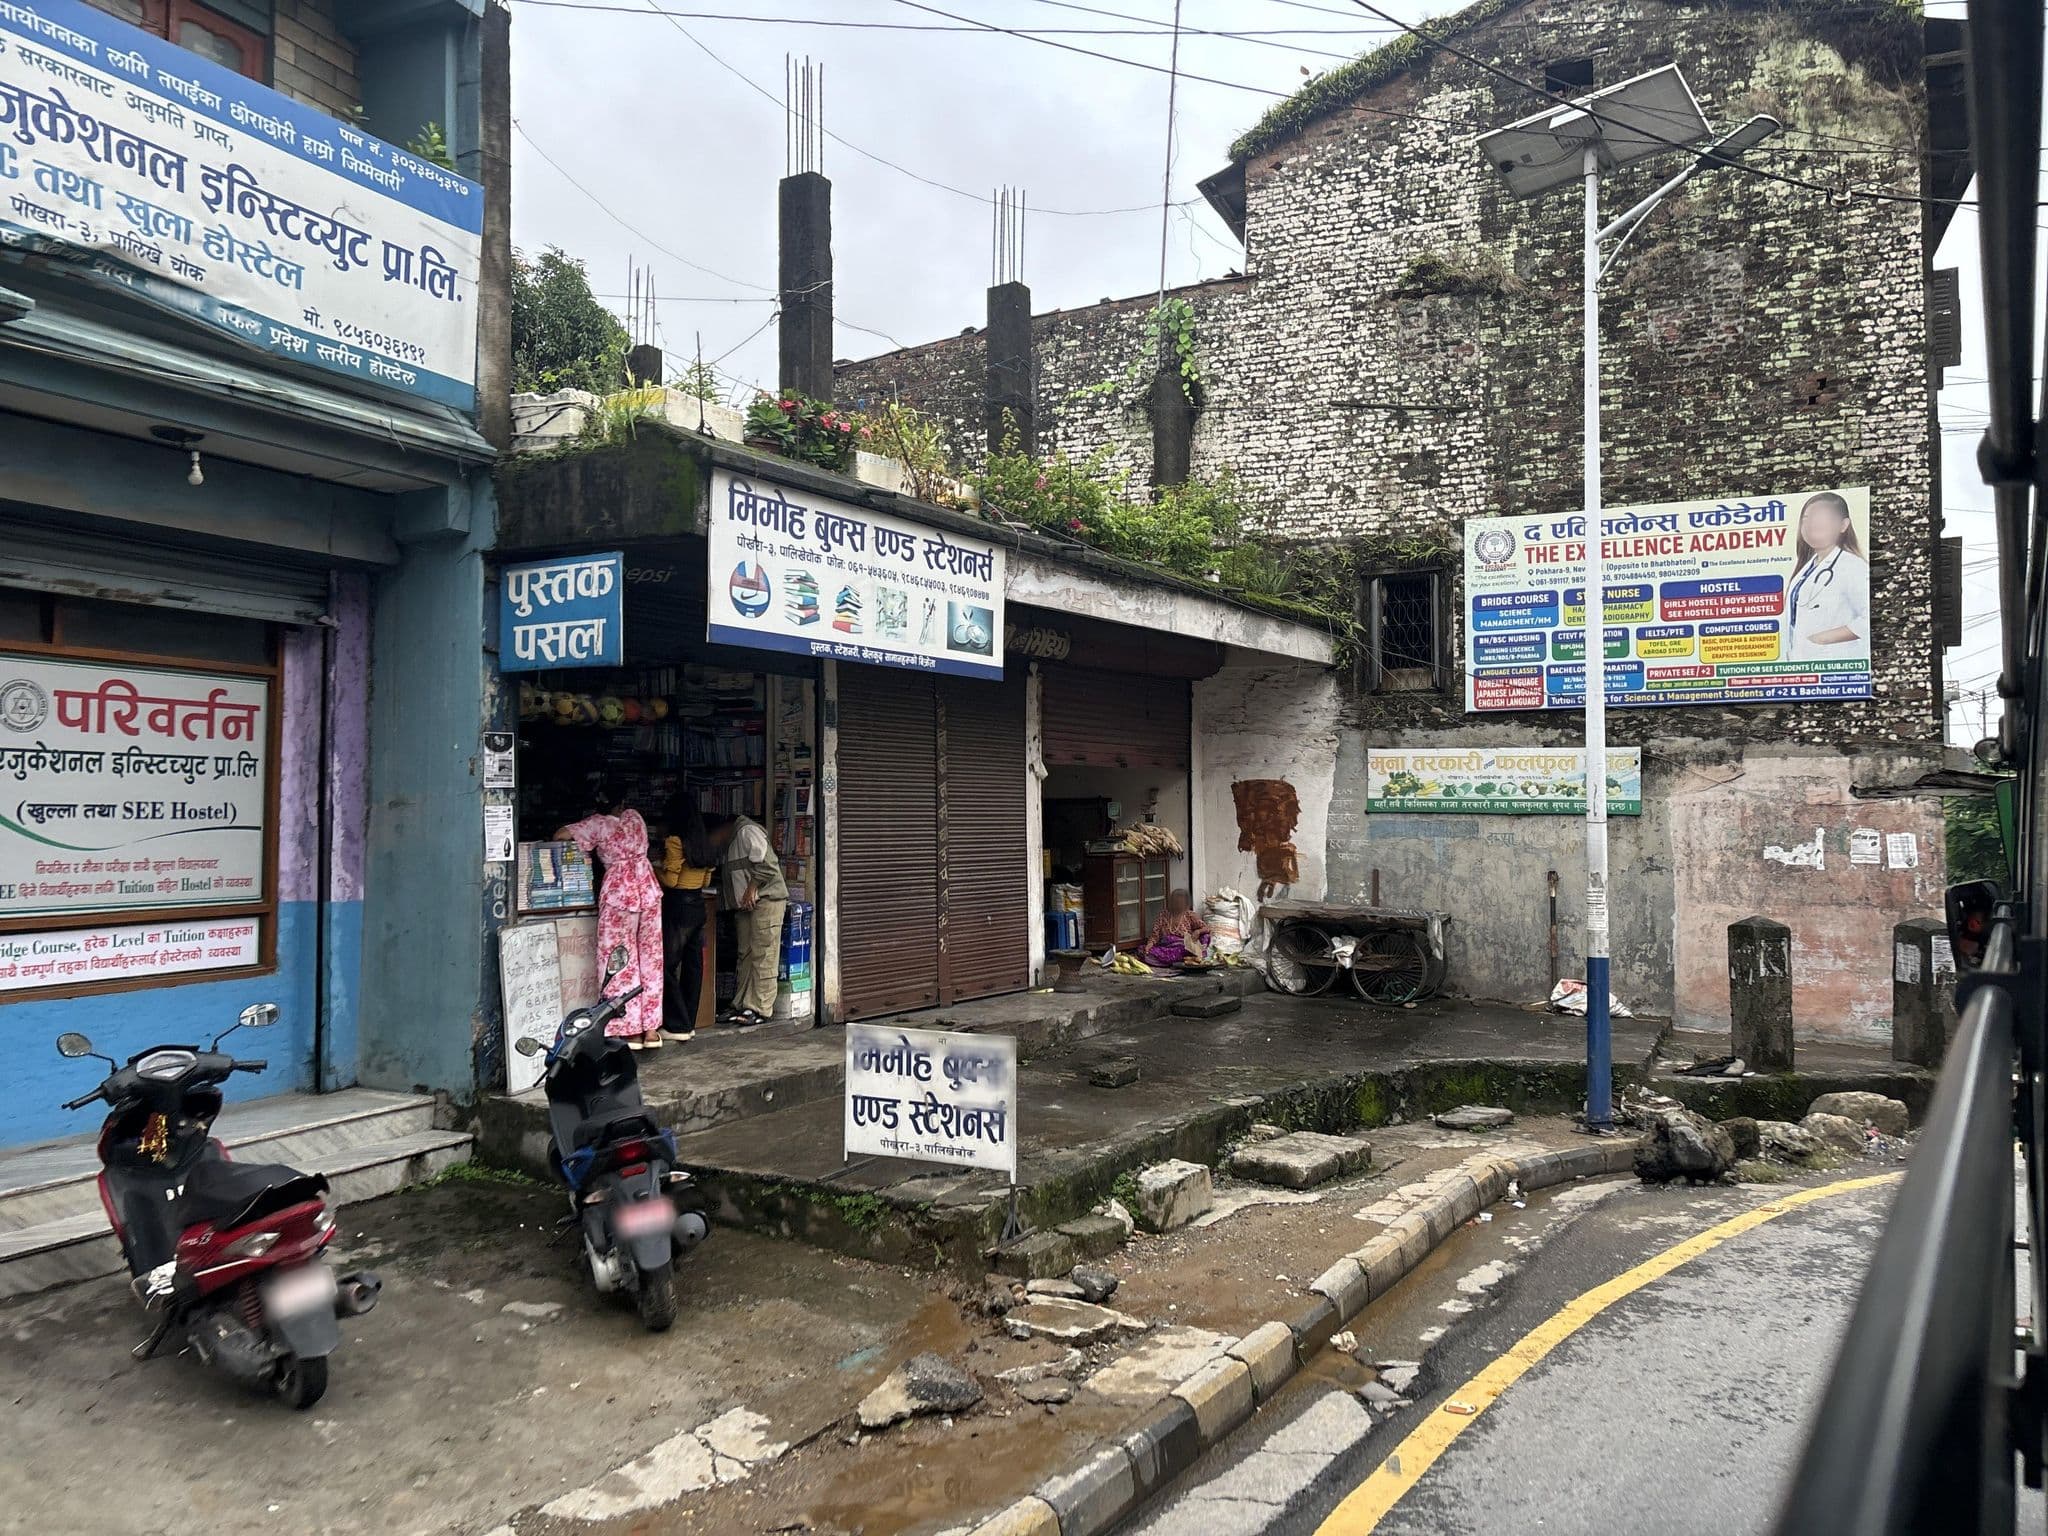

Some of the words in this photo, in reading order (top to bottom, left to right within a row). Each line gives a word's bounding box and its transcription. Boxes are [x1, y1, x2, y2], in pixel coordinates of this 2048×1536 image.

[106, 47, 149, 79] लागि
[302, 133, 335, 163] हाम्रो
[124, 91, 184, 130] अनुमति
[33, 159, 103, 211] तथा
[115, 190, 193, 245] खुला
[203, 223, 305, 291] होस्टेल
[170, 254, 206, 282] चोक
[270, 327, 310, 354] प्रदेश
[316, 342, 363, 369] स्तरीय
[368, 356, 417, 386] होस्टेल
[1524, 524, 1543, 541] द
[1688, 500, 1787, 527] एकेडेमी
[728, 478, 807, 540] मिमोह
[815, 510, 867, 553] बुक्स
[874, 526, 917, 562] एण्ड
[923, 533, 994, 582] स्टेशनर्स
[1525, 545, 1559, 564] THE
[1566, 536, 1684, 562] EXELLENCE
[1690, 528, 1787, 552] ACADEMY
[506, 559, 617, 617] पुस्तक
[1607, 588, 1640, 598] NURSE
[1700, 582, 1741, 593] HOSTEL
[1481, 597, 1513, 607] BRIDGE
[1514, 593, 1550, 605] COURSE
[1688, 599, 1719, 607] HOSTEL
[1725, 597, 1744, 605] BOYS
[1745, 595, 1779, 603] HOSTEL
[1603, 612, 1650, 621] ADIOGRAPHY
[1684, 609, 1715, 617] HOSTEL
[1720, 607, 1743, 615] OPEN
[1744, 605, 1776, 613] HOSTEL
[1645, 628, 1685, 637] IELTS/PTE
[1705, 625, 1744, 634] COMPUTER
[1745, 623, 1773, 631] COURSE
[1508, 633, 1540, 642] NURSING
[1479, 668, 1510, 676] LANGUAGE
[1511, 666, 1538, 675] CLASSES
[1650, 669, 1681, 677] PRIVATE
[1719, 666, 1746, 674] TUITION
[1761, 665, 1774, 673] SEE
[1774, 664, 1810, 672] STUDENTS
[1827, 661, 1866, 670] SUBJECTS)
[1478, 679, 1505, 688] KOREAN
[1506, 677, 1538, 687] LANGUAGE
[1477, 689, 1507, 698] JAPANESE
[1624, 694, 1658, 702] Science
[1667, 690, 1722, 702] Management
[1724, 688, 1764, 698] Students
[1765, 688, 1775, 696] of
[1777, 688, 1789, 696] +2
[1799, 686, 1840, 695] Bachelor
[1842, 685, 1866, 694] Level
[53, 679, 261, 742] परिवर्तन
[1478, 699, 1506, 708] ENGLISH
[1506, 697, 1539, 706] LANGUAGE
[1412, 751, 1483, 772] तरकारी
[83, 803, 117, 819] तथा
[122, 801, 164, 820] SEE
[171, 801, 237, 825] Hostel)
[118, 879, 154, 894] Tuition
[181, 877, 211, 891] Hostel
[84, 936, 110, 952] हरेक
[113, 932, 144, 948] Level
[164, 929, 205, 944] Tuition
[852, 1095, 900, 1129] एण्ड
[909, 1092, 1007, 1144] स्टेशनर्स
